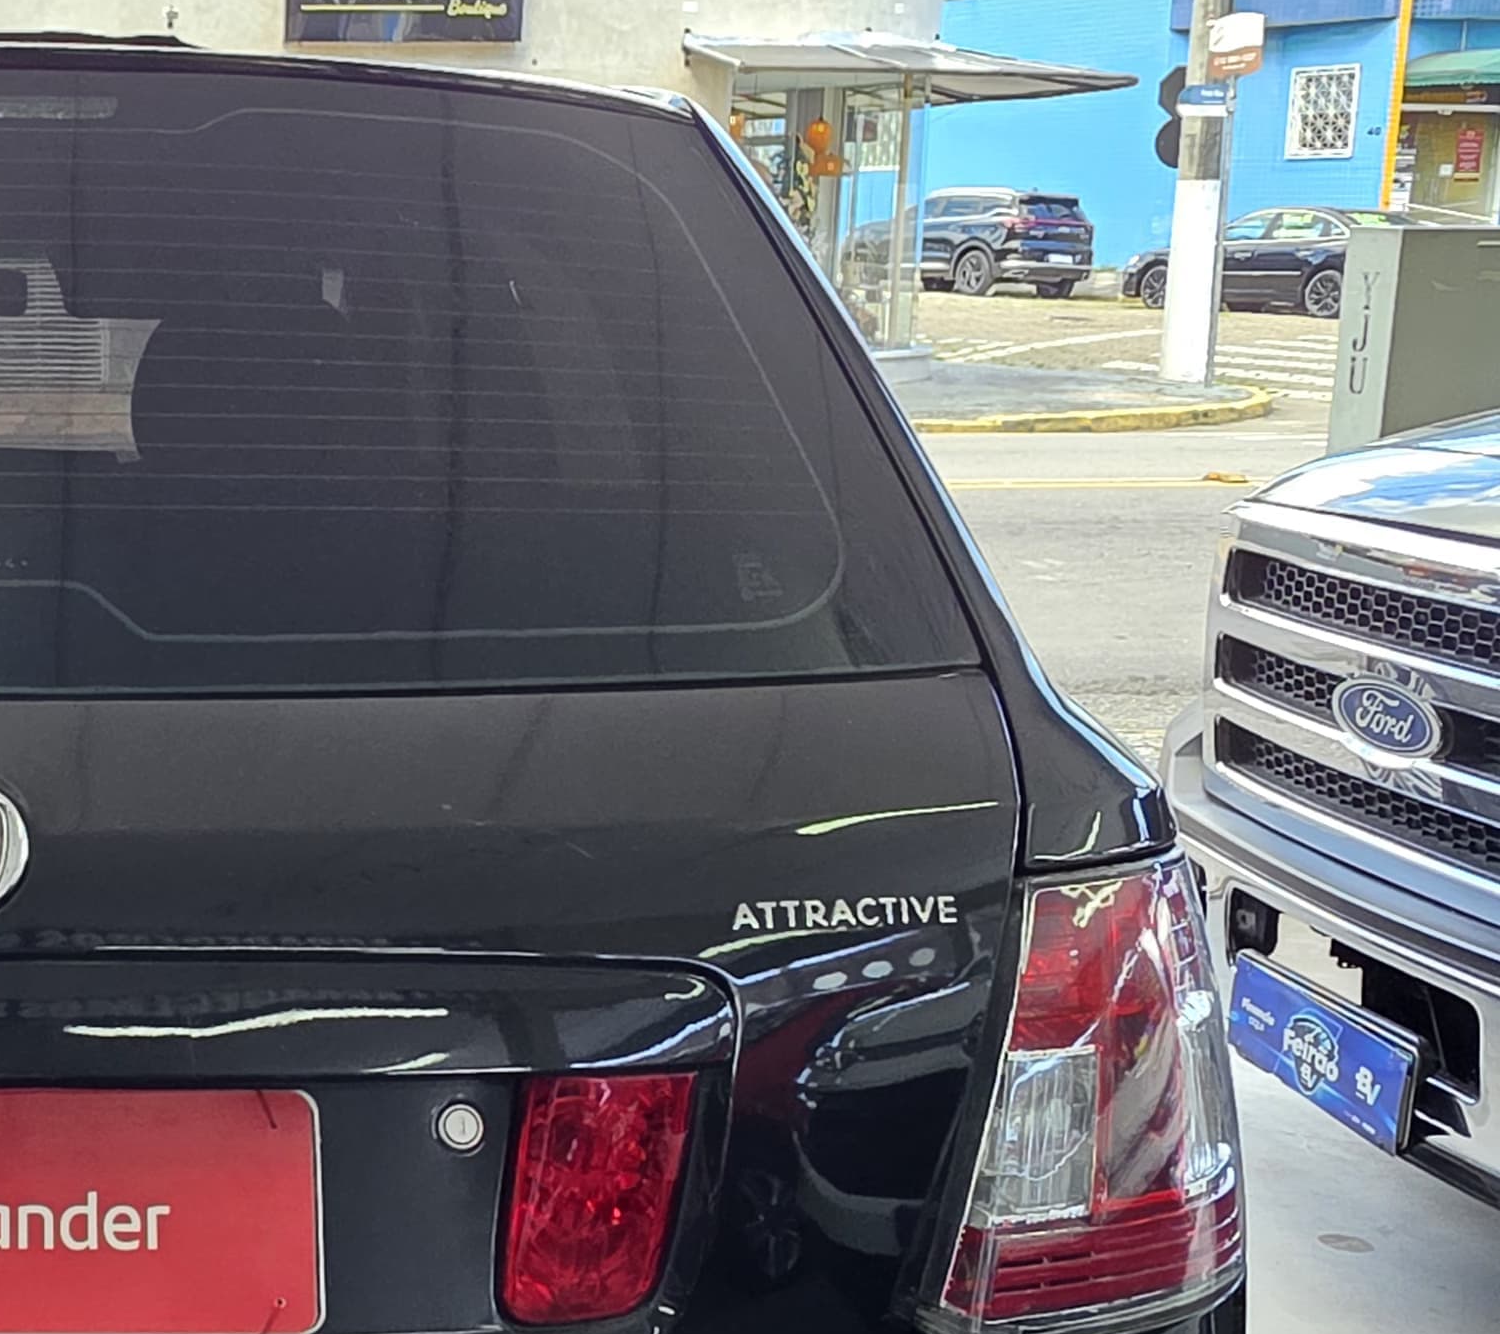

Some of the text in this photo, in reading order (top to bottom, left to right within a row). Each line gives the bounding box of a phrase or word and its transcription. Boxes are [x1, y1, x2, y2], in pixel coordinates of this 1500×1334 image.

[1355, 690, 1414, 744] Ford
[732, 895, 959, 931] ATTRACTIVE
[1283, 1026, 1339, 1083] Feirão
[1355, 1066, 1382, 1107] BV
